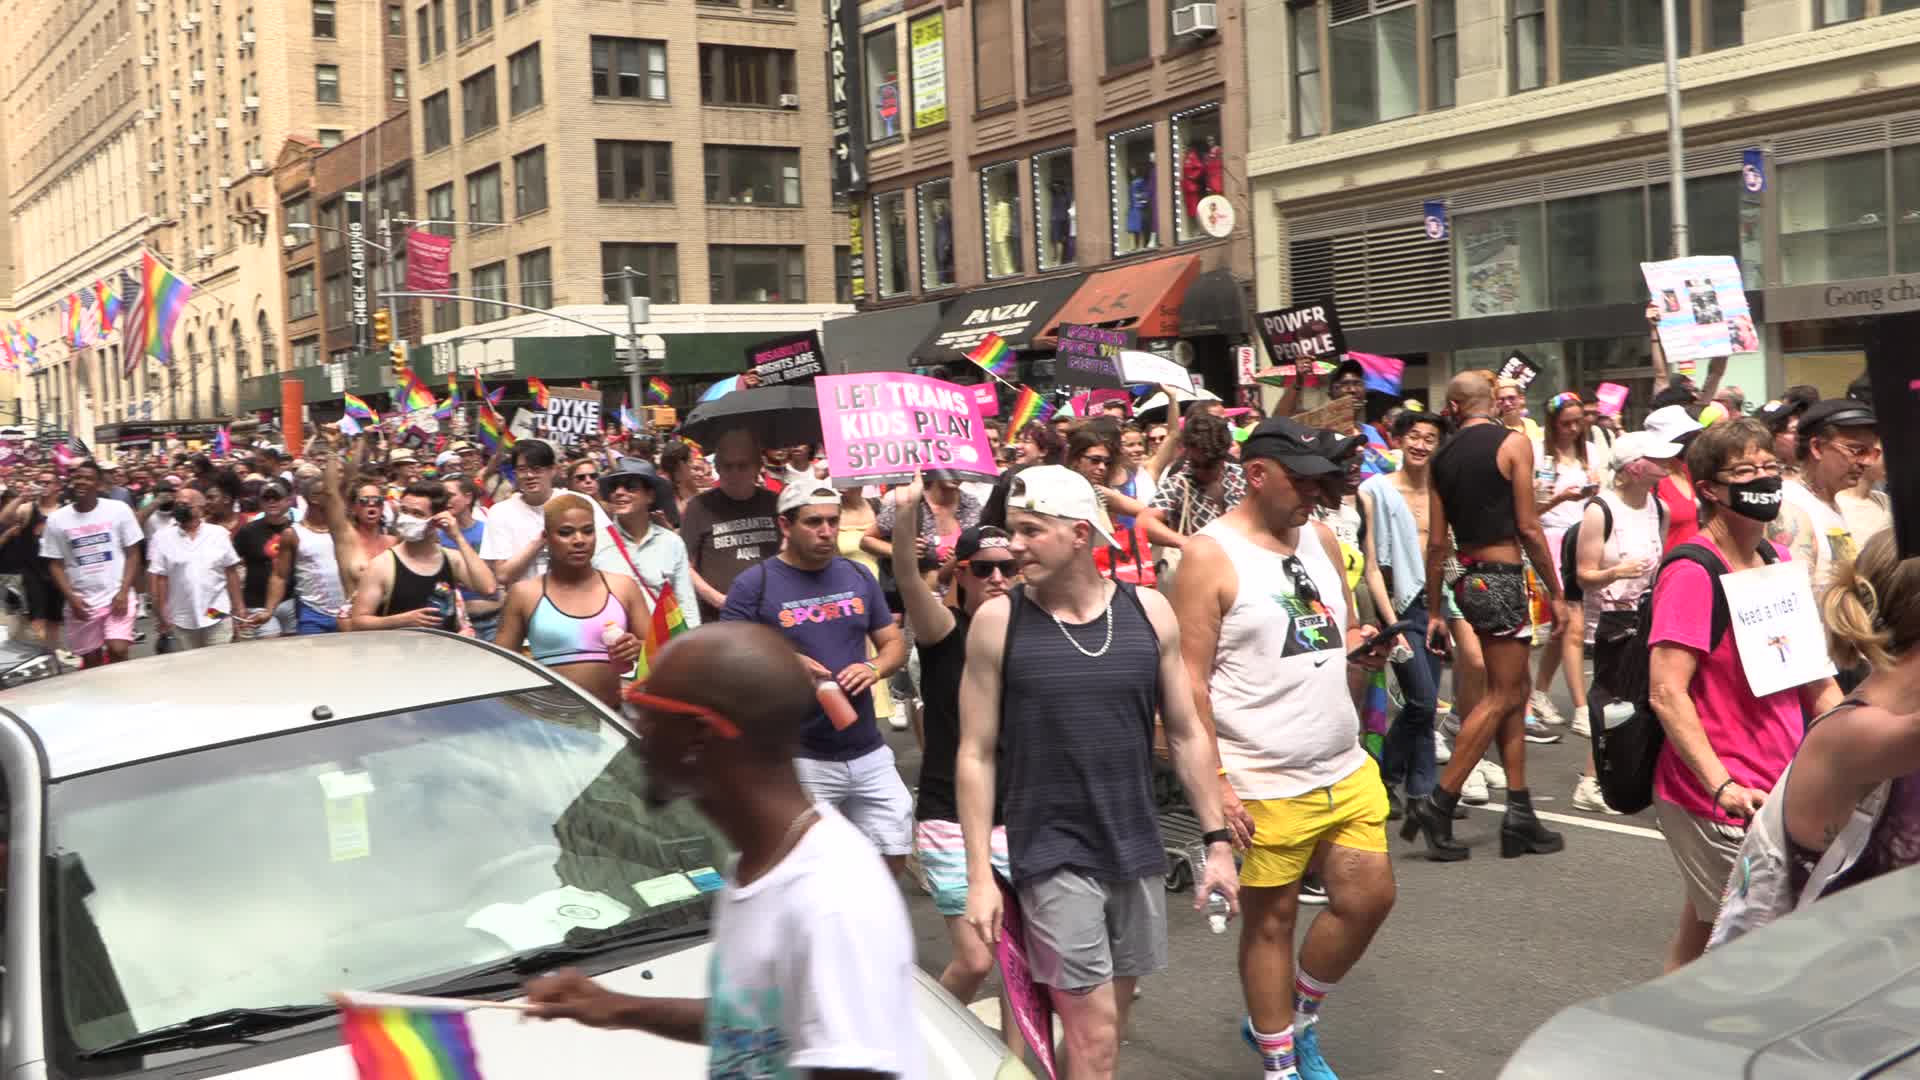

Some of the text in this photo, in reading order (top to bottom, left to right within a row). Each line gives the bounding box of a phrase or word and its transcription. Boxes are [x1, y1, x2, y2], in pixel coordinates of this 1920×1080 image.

[830, 0, 847, 103] PARK
[1824, 285, 1885, 310] Gong
[1263, 305, 1328, 335] POWER
[794, 351, 817, 366] ARE
[1273, 333, 1336, 361] PEOPLE
[548, 397, 600, 418] DYKE
[834, 383, 879, 410] LET
[886, 381, 969, 416] TRANS
[548, 413, 599, 435] LOVE
[840, 410, 973, 440] KIDS PLAY
[847, 439, 952, 469] SPORTS
[778, 597, 865, 628] SPORTS
[1738, 591, 1800, 626] Need a ride?
